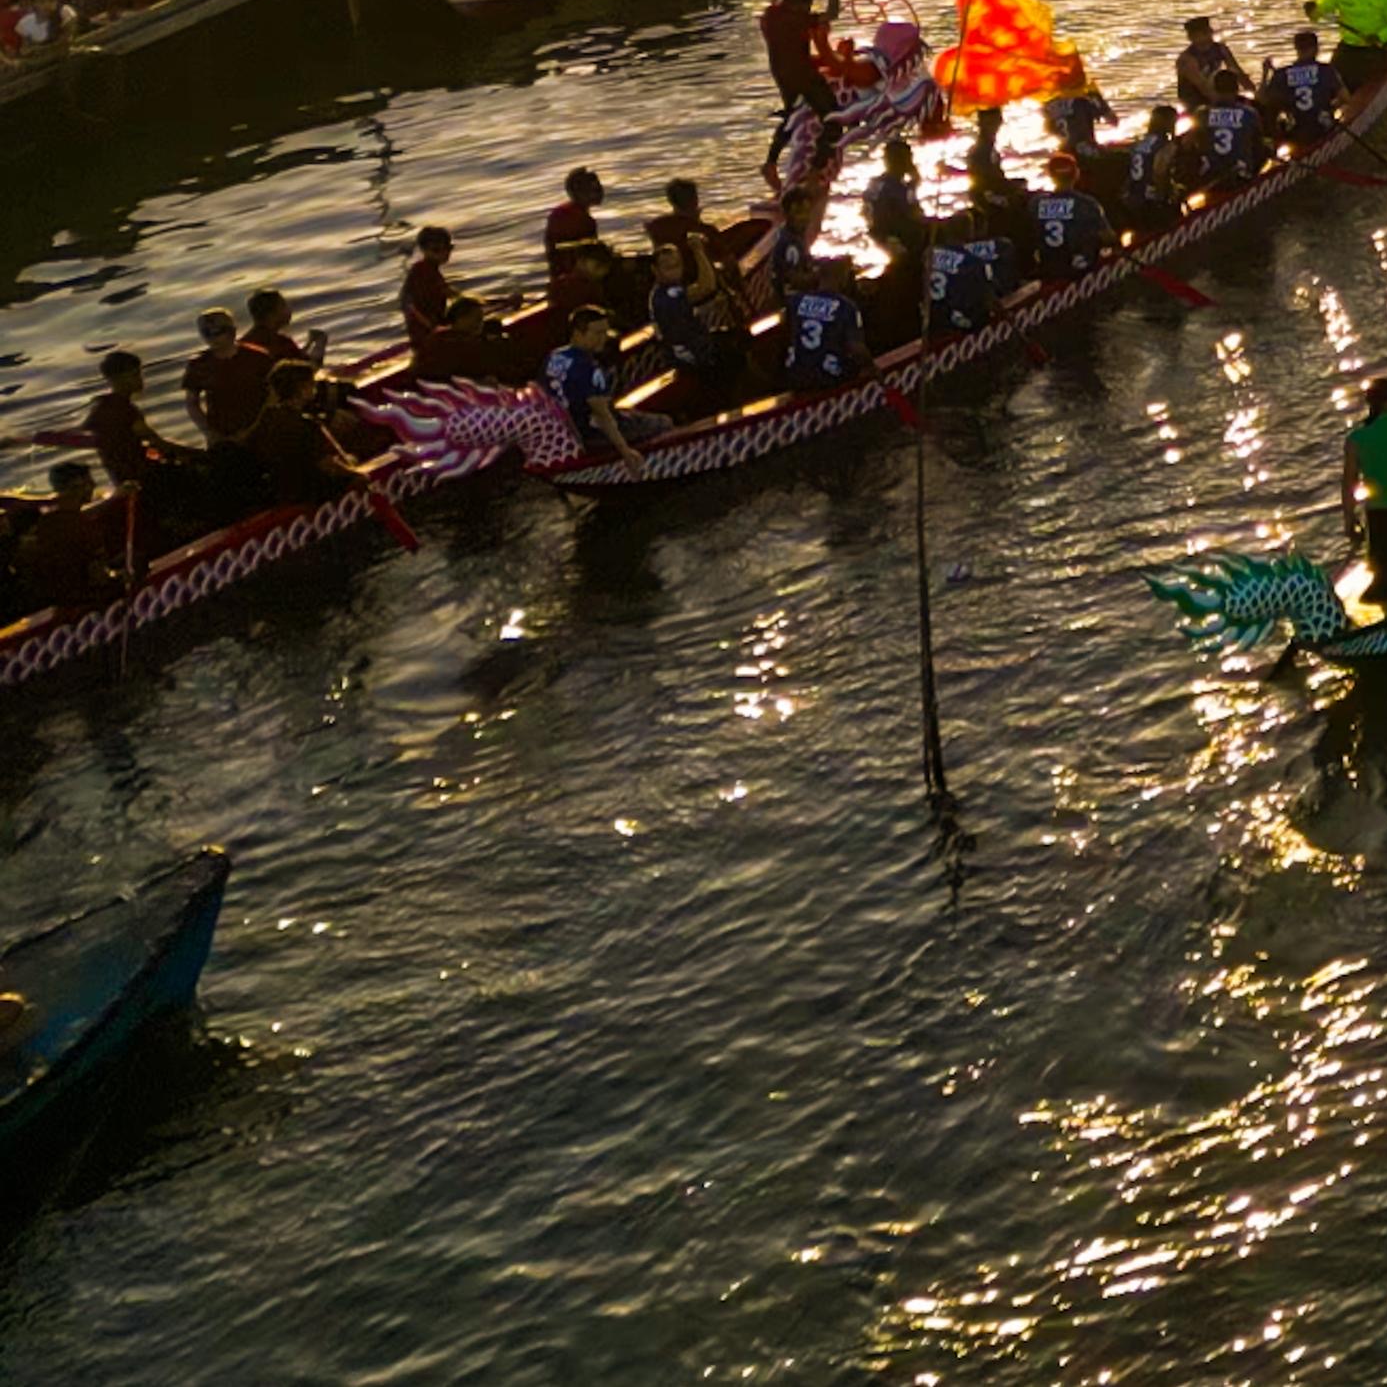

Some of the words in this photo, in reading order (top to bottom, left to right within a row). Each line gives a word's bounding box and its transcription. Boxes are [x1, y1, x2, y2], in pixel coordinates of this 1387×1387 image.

[1294, 86, 1313, 111] 3
[1213, 128, 1234, 154] 3
[1130, 153, 1144, 181] 3
[1045, 220, 1065, 248] 3
[929, 272, 948, 301] 3
[800, 320, 823, 350] 3
